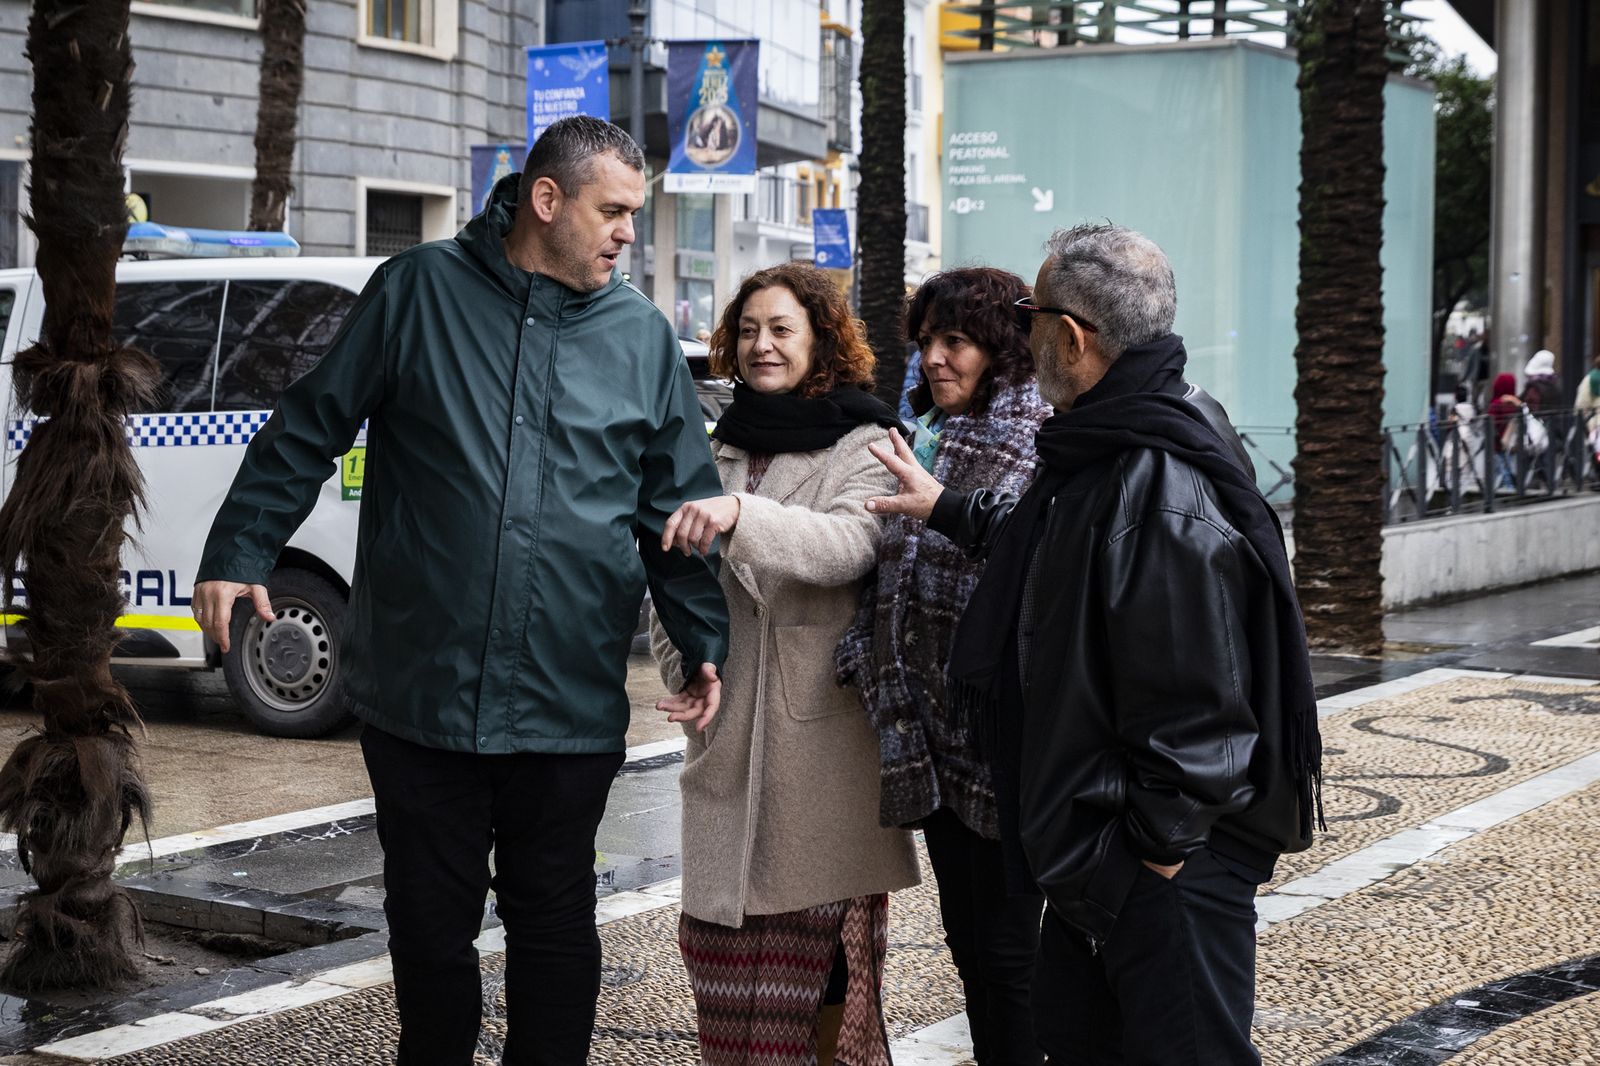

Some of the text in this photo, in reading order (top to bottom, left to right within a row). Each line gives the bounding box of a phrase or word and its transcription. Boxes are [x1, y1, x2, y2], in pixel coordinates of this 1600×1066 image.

[544, 87, 585, 100] CONFIANZA
[949, 131, 998, 145] ACCESO
[949, 146, 1010, 160] PEATONAL
